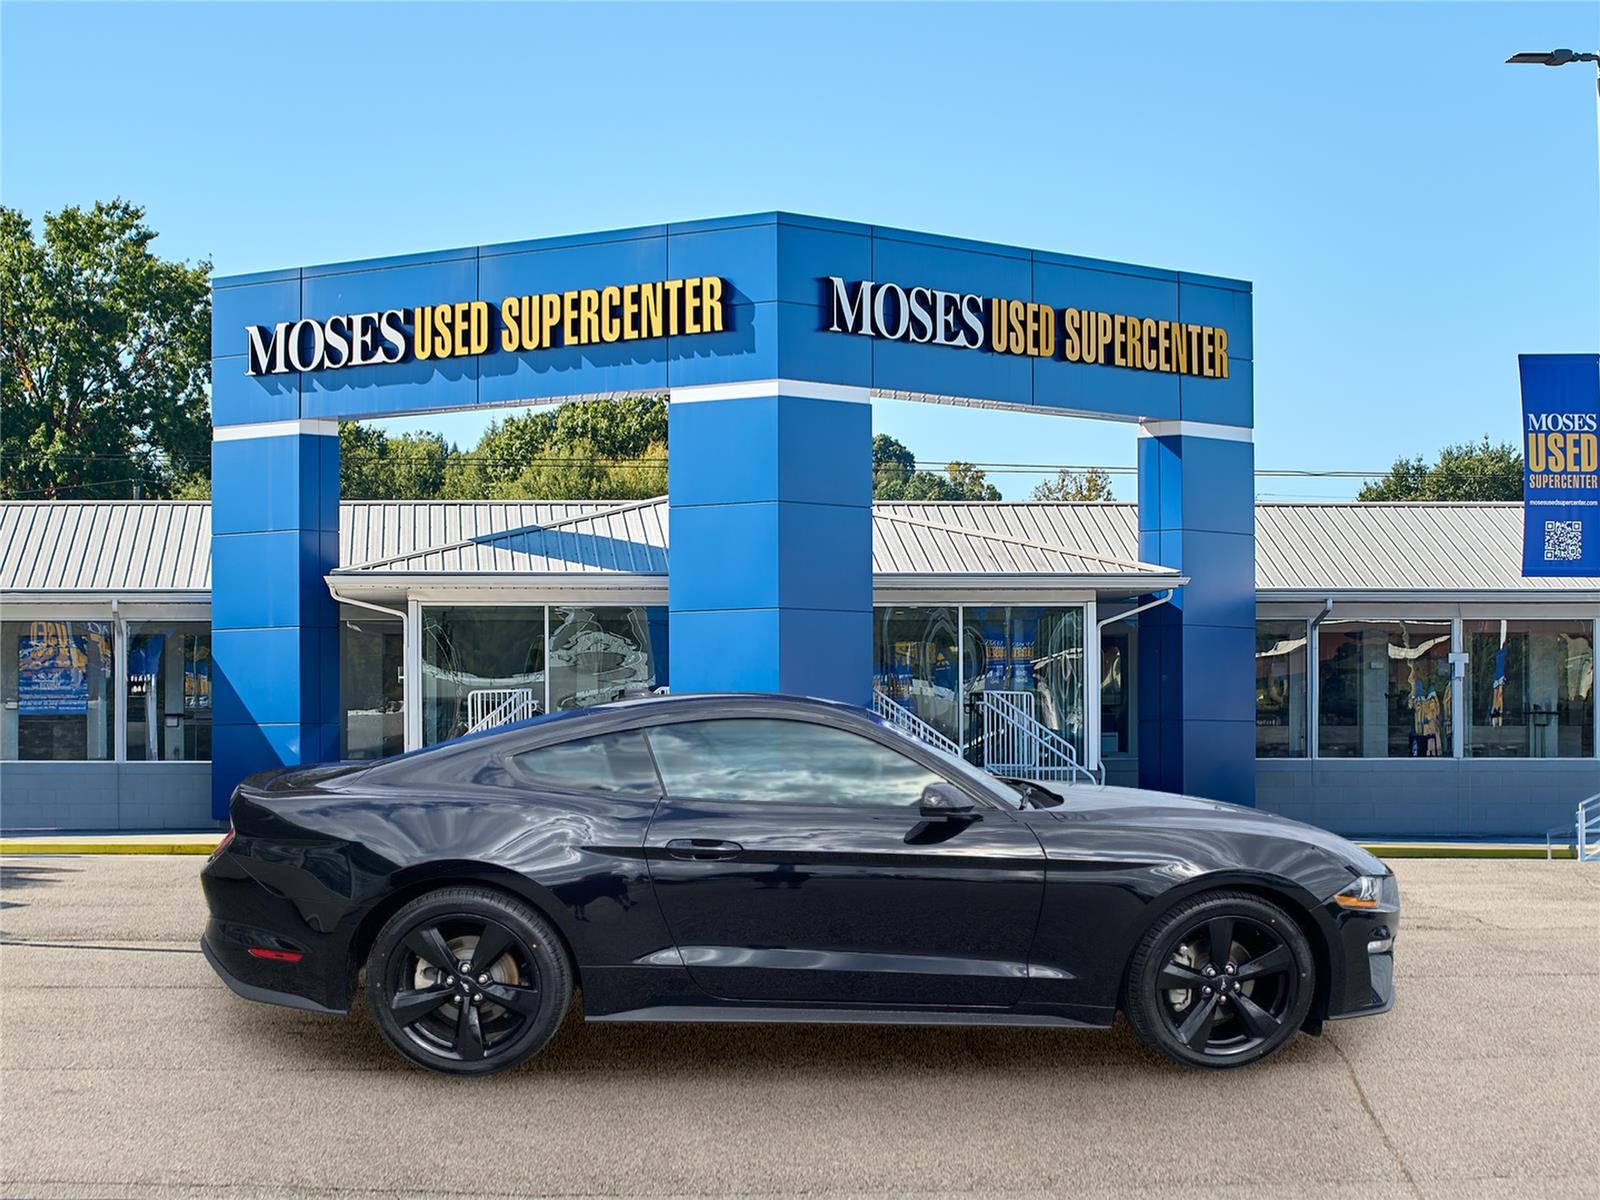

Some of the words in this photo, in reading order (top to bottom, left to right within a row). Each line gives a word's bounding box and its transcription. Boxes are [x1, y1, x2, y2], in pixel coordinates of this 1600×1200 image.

[245, 308, 409, 377] MOSES
[413, 300, 490, 361] USED
[501, 276, 724, 353] SUPERCENTER
[828, 275, 985, 349] MOSES
[991, 297, 1056, 357] USED
[1065, 307, 1230, 379] SUPERCENTER
[1527, 413, 1597, 432] MOSES
[1528, 432, 1598, 473] USED
[1529, 474, 1598, 489] SUPERCENTER
[1529, 499, 1598, 507] mosesusedsupercenter.com
